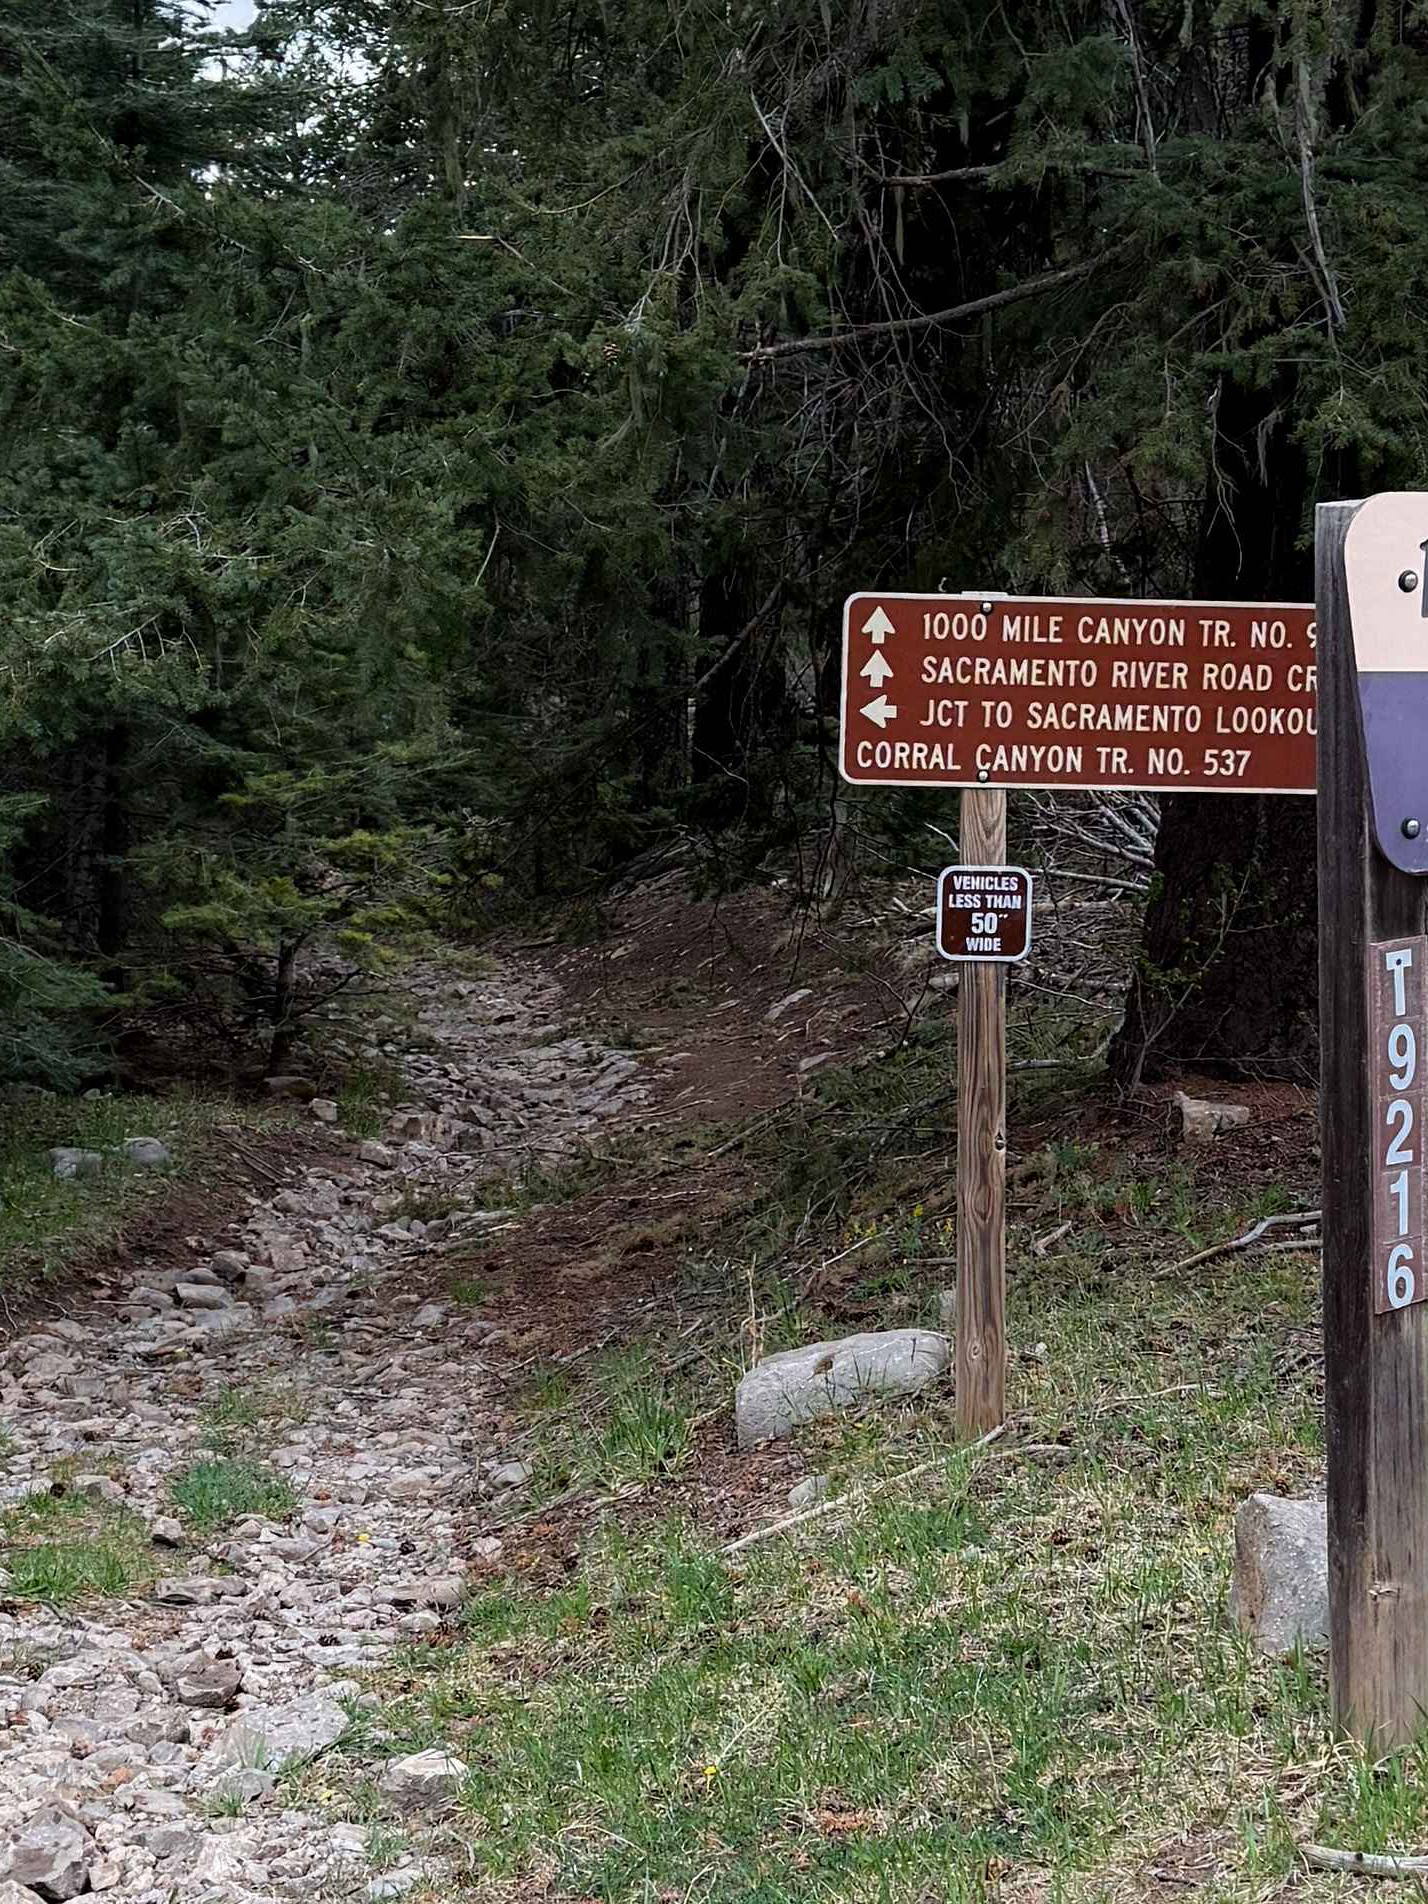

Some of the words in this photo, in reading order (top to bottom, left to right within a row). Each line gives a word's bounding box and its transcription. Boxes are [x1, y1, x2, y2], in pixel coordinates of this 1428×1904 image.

[923, 612, 988, 641] 1000
[1002, 614, 1063, 644] MILE
[1077, 616, 1185, 647] CANYON
[1199, 619, 1236, 647] TR.
[1250, 620, 1293, 649] NO.
[920, 656, 1098, 688] SACRAMENTO
[1111, 660, 1188, 690] RIVER
[1202, 662, 1273, 692] ROAD
[919, 699, 969, 728] JCT
[981, 701, 1013, 729] TO
[1027, 702, 1201, 733] SACRAMENTO
[856, 741, 961, 771] CORRAL
[975, 742, 1084, 774] CANYON
[1097, 746, 1134, 775] TR.
[1147, 748, 1190, 776] NO.
[1203, 749, 1251, 776] 537
[953, 875, 1019, 891] VEHICLES
[948, 894, 982, 909] LESS
[985, 894, 1022, 909] THAN
[965, 936, 1002, 952] WIDE
